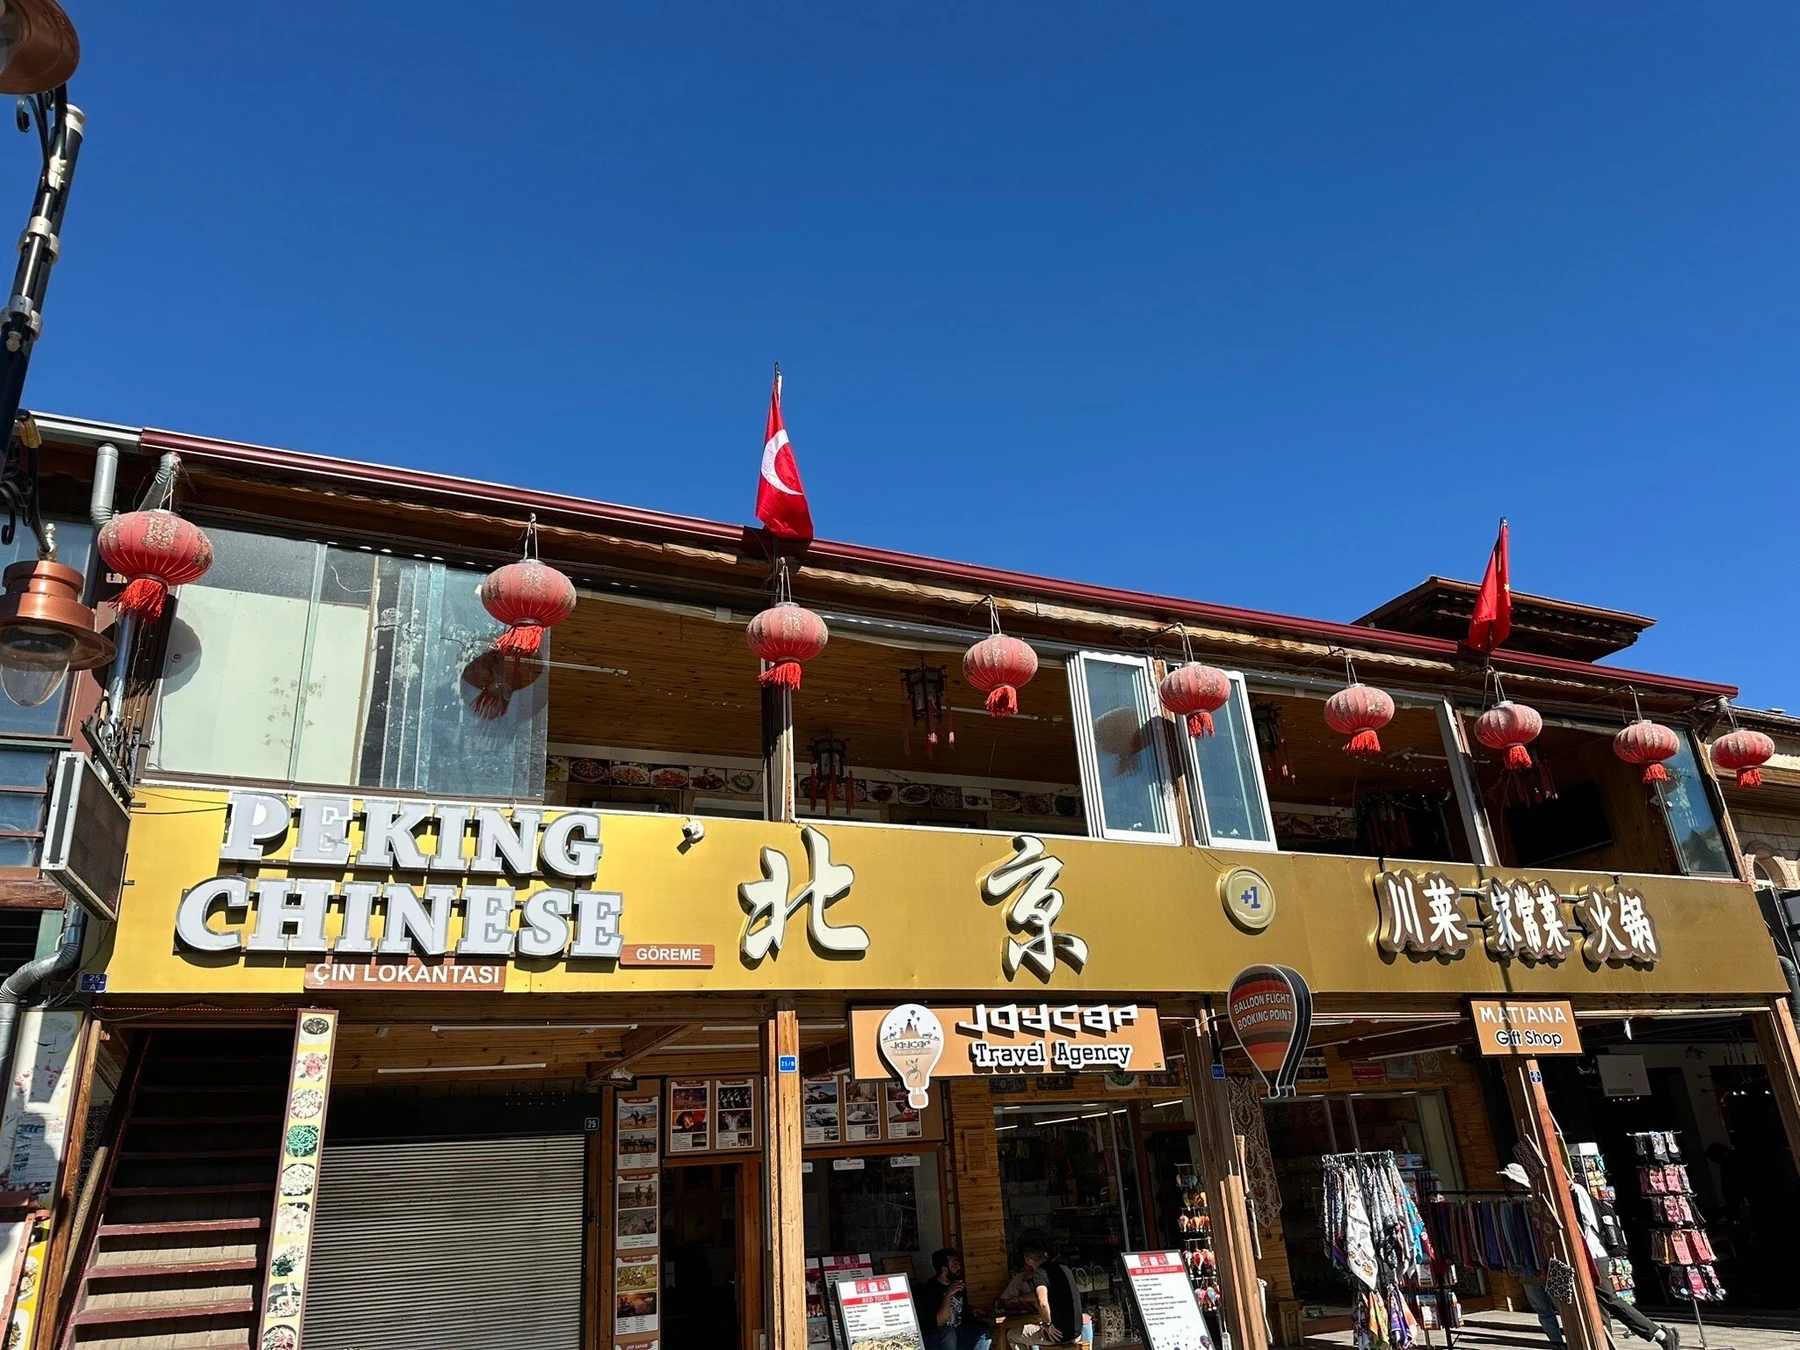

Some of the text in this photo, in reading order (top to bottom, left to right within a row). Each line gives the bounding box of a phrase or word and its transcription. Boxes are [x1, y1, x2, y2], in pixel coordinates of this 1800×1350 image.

[219, 790, 603, 878] PEKING
[174, 875, 624, 957] CHINESE
[1388, 876, 1468, 947] 川菜
[1491, 882, 1571, 953] 家常菜
[1588, 888, 1657, 954] 火锅
[636, 946, 701, 962] GÖREME
[89, 974, 101, 982] 25
[363, 964, 500, 984] LOKANTASI
[1233, 992, 1291, 1014] BALLOON FLIGHT
[1237, 1009, 1292, 1030] BOOKING POINT
[1479, 1006, 1568, 1024] MATIANA
[1496, 1030, 1562, 1048] Gift Shop
[975, 1042, 1131, 1065] Travel Agency
[588, 1120, 597, 1129] 25
